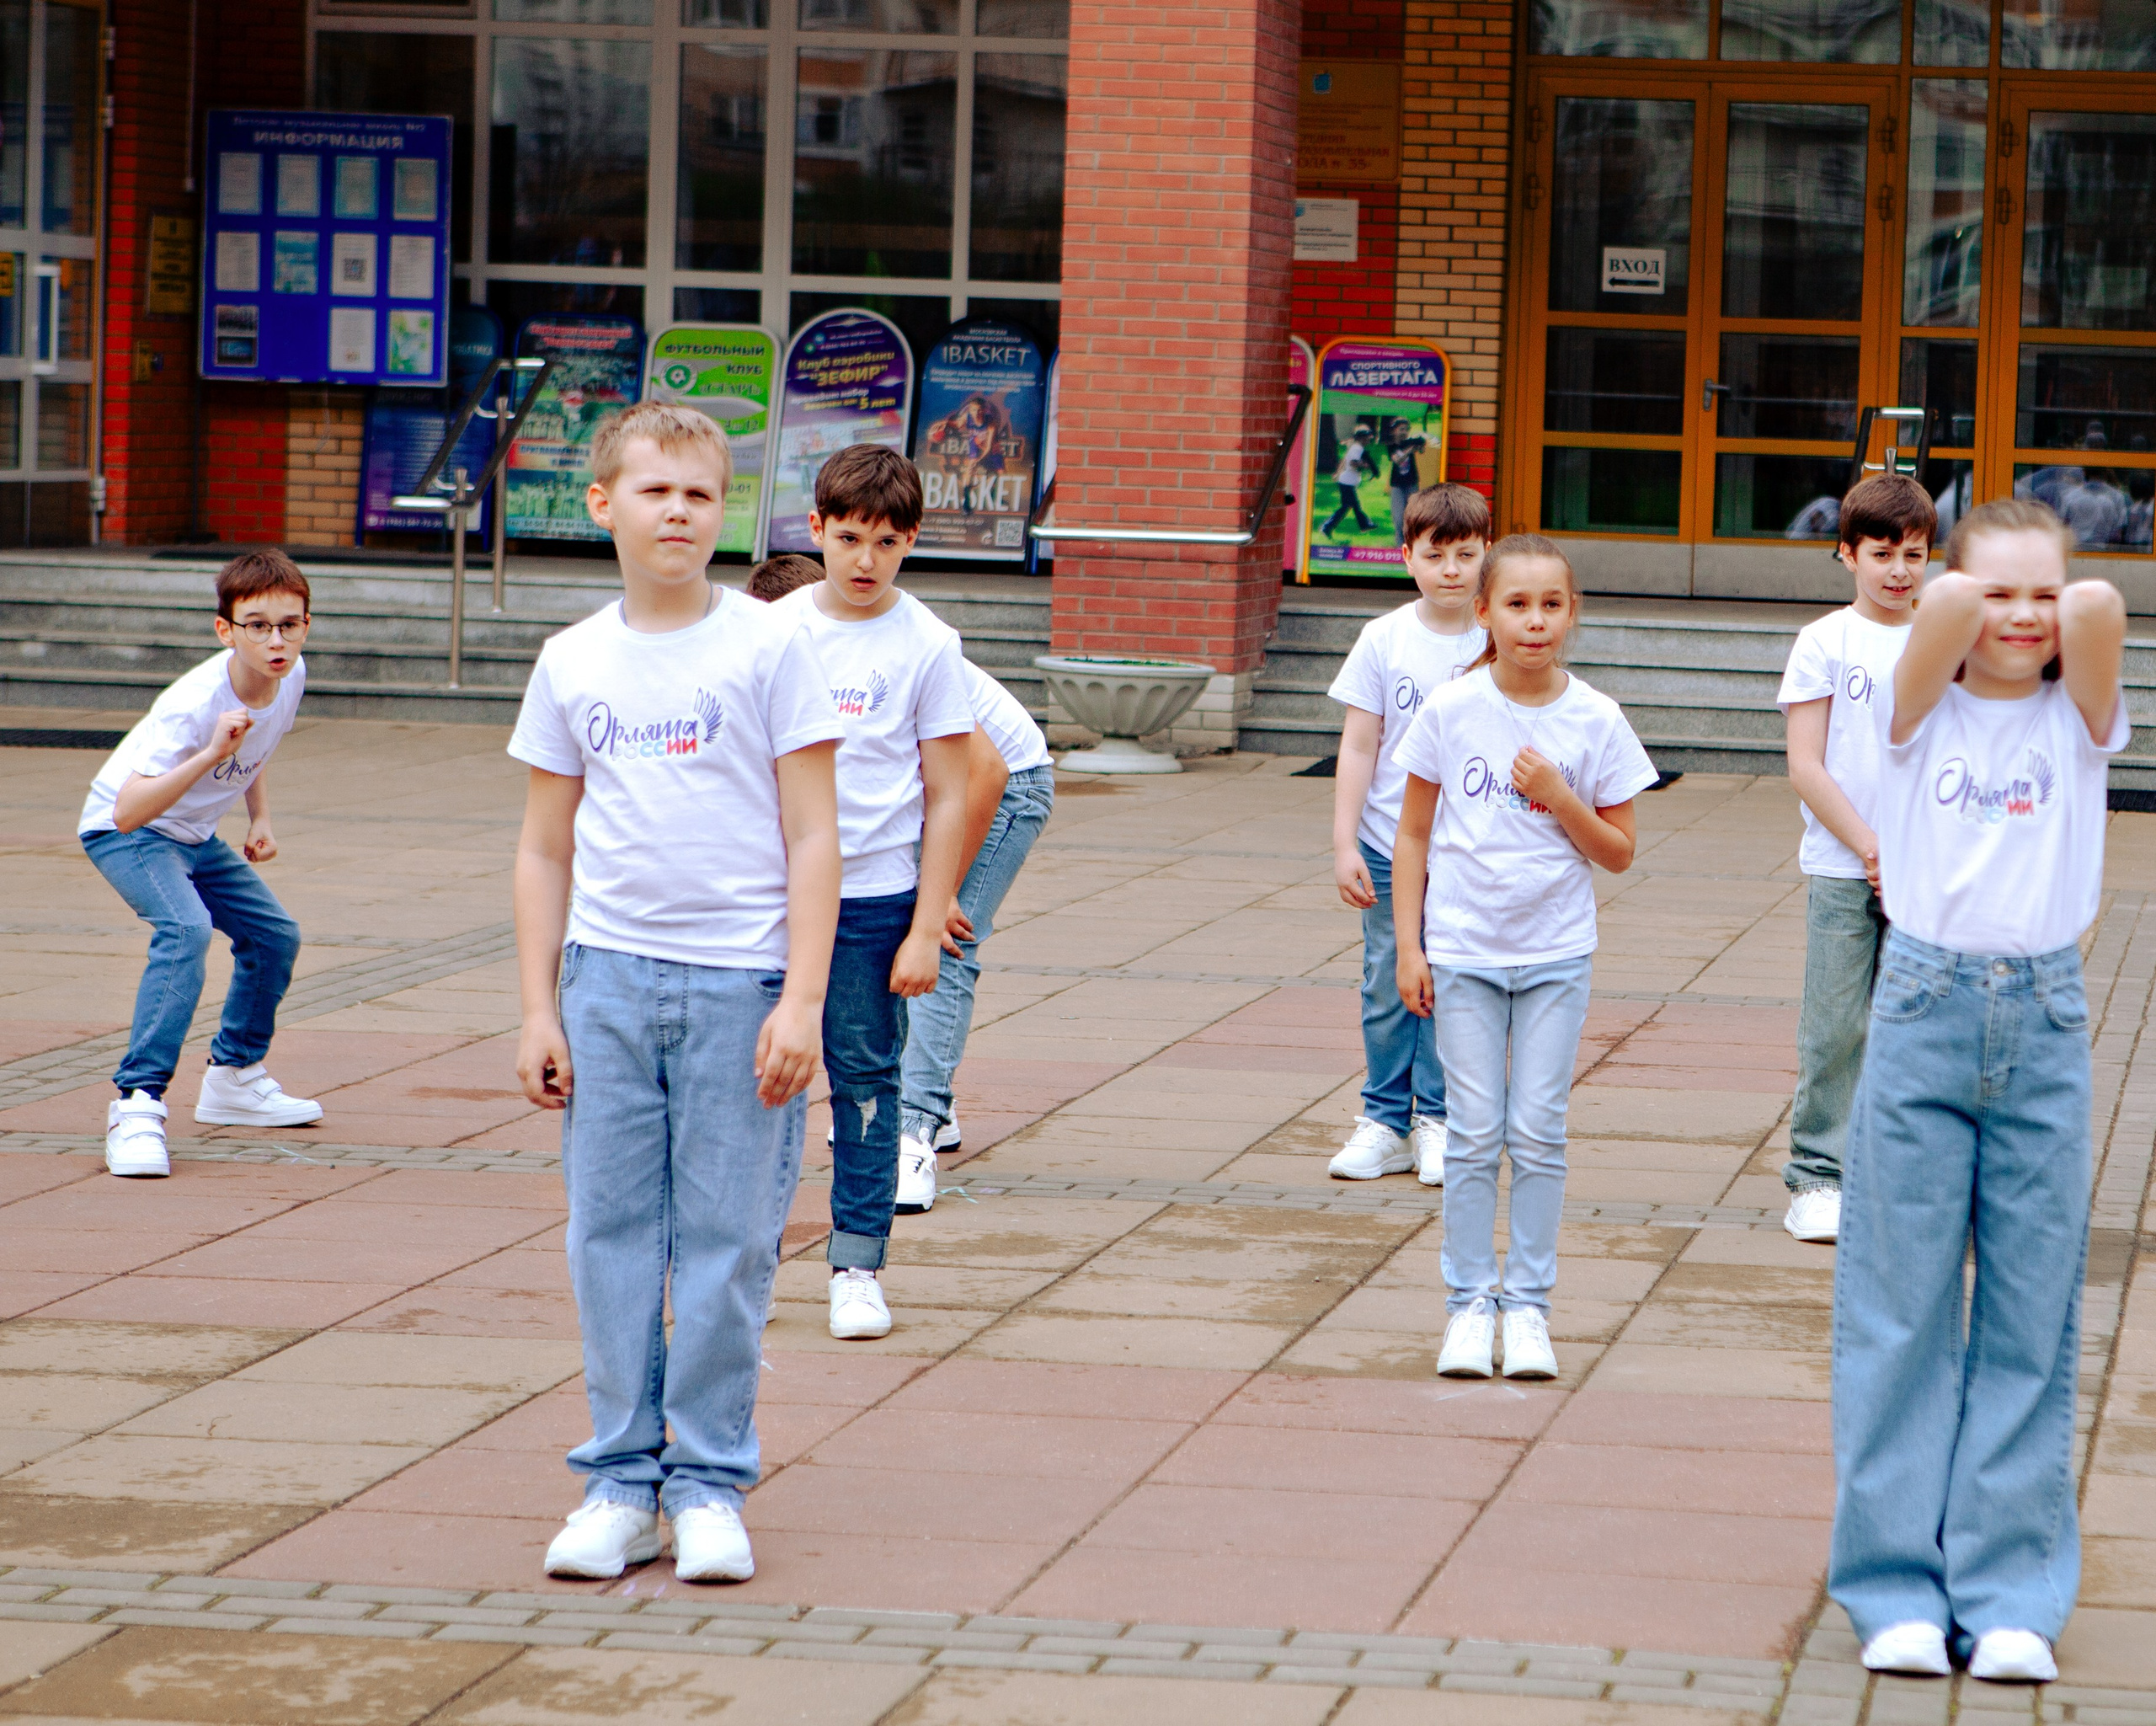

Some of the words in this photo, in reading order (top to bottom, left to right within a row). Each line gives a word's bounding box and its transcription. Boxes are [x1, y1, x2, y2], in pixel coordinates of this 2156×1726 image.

[254, 131, 404, 149] ИНФОРМАЦИЯ
[1609, 259, 1660, 275] ВХОД
[664, 344, 766, 355] ФУТБОЛЬНЫЙ
[942, 344, 1031, 367] IBASKET
[726, 364, 762, 375] КЛУБ
[797, 357, 830, 371] Клуб
[832, 351, 895, 366] аэробики
[1351, 361, 1421, 370] СПОРТИВНОГО
[1331, 370, 1438, 387] ЛАЗЕРТАГА
[860, 397, 869, 410] 5
[871, 398, 896, 409] лет
[587, 702, 698, 756] Орлята
[611, 738, 698, 761] РОССИИ
